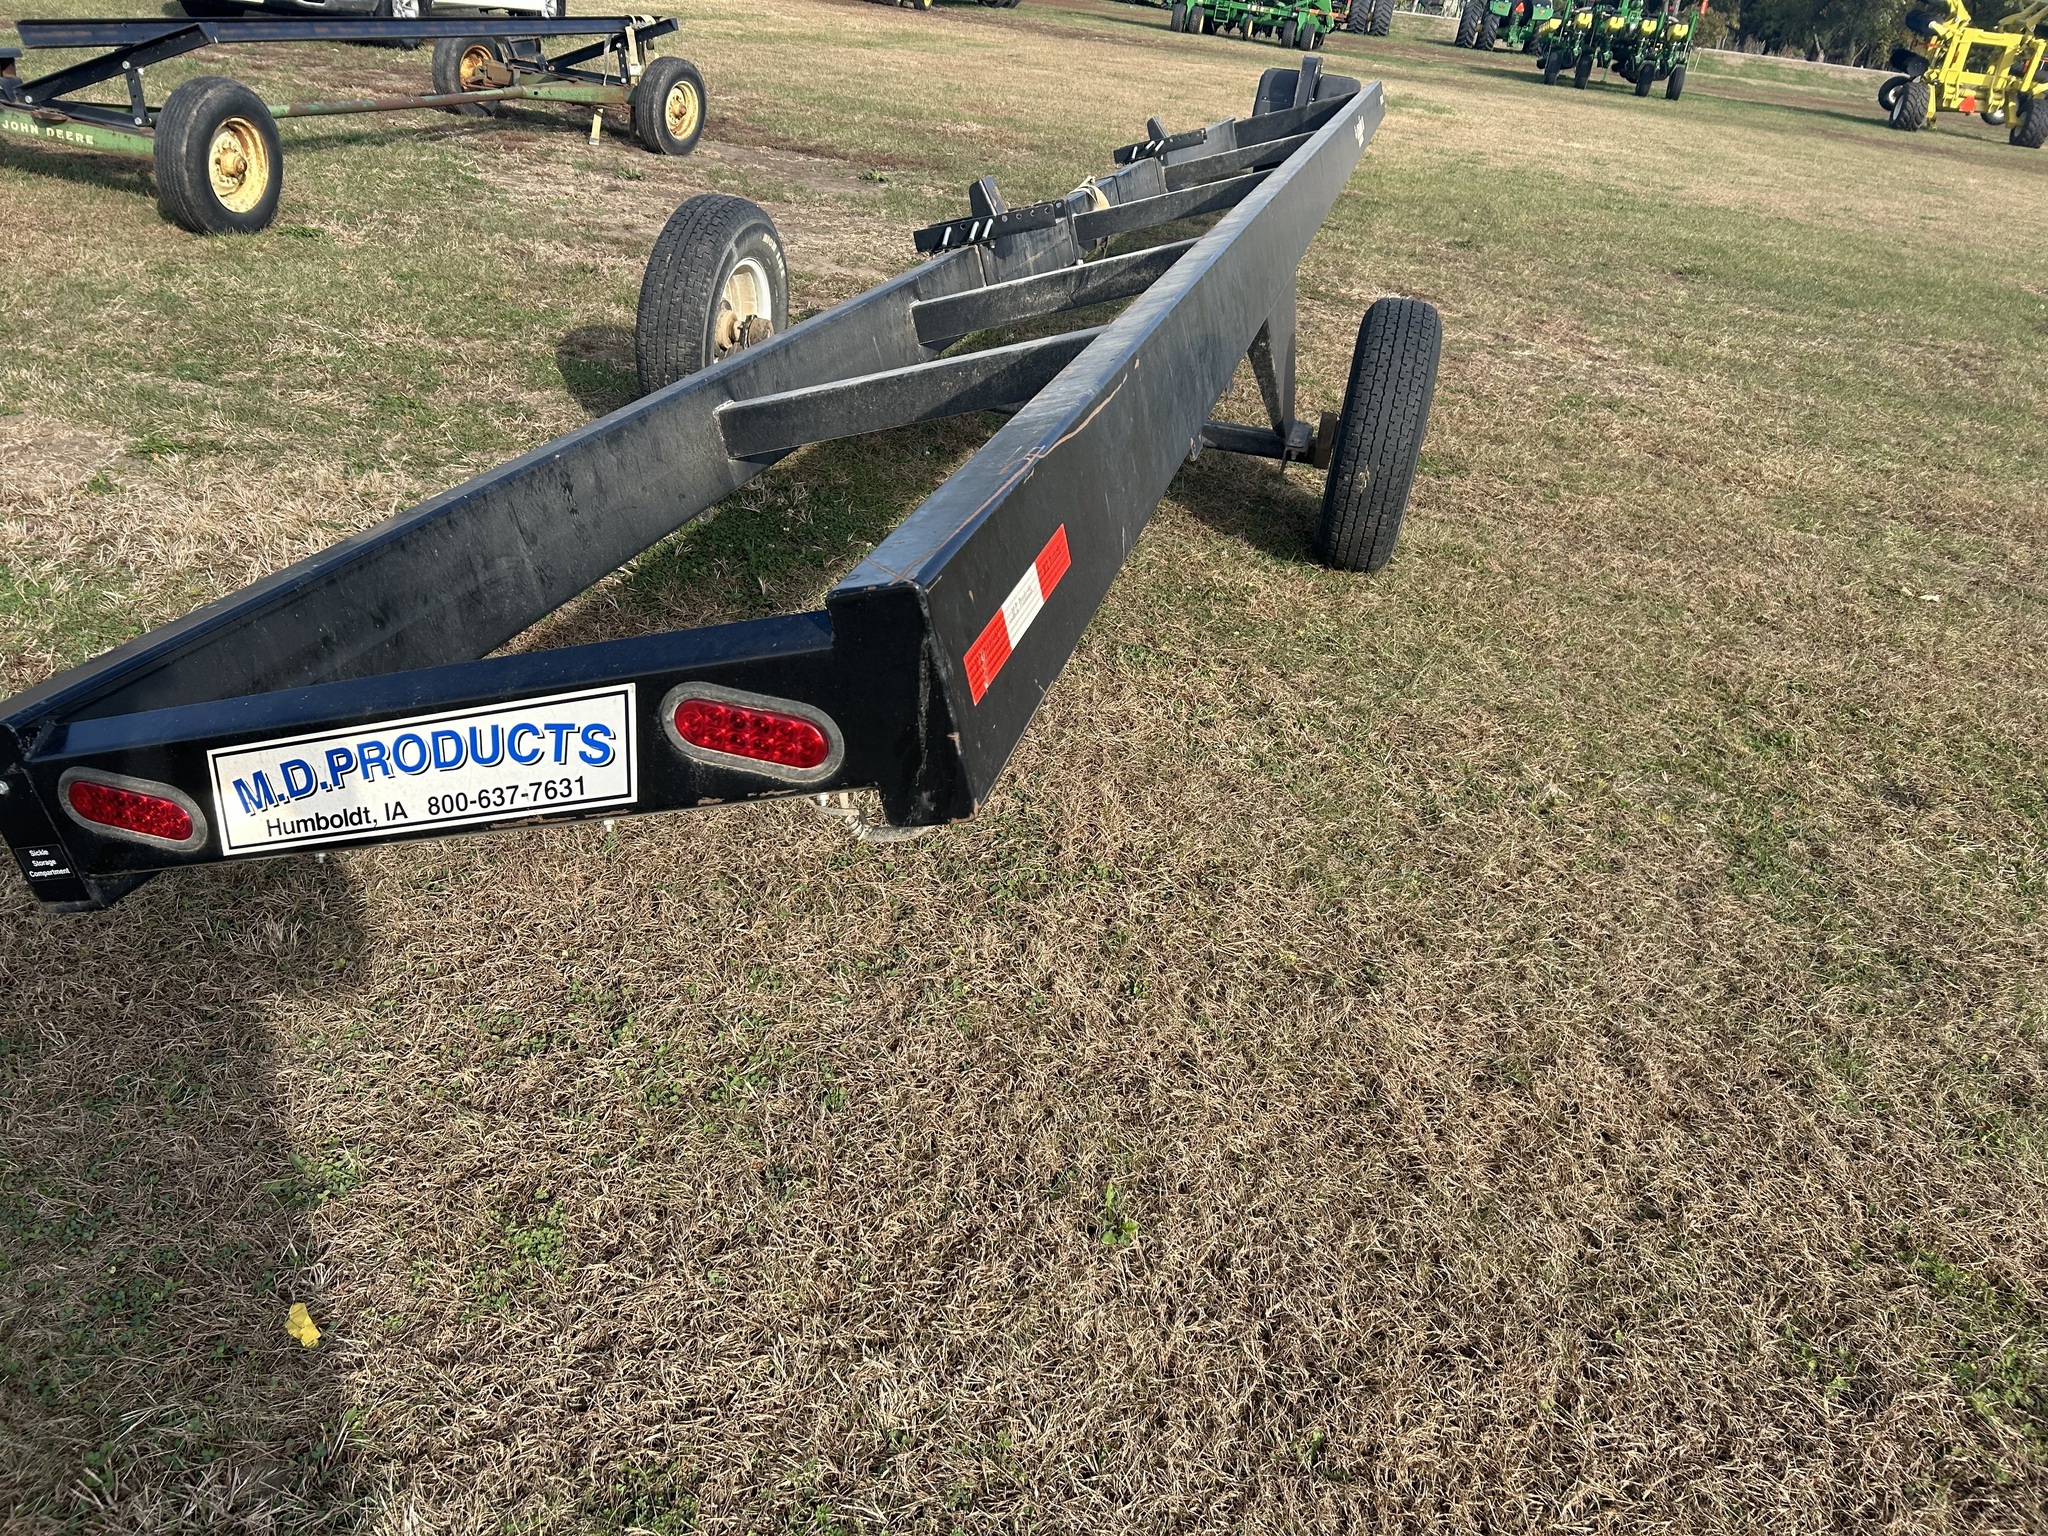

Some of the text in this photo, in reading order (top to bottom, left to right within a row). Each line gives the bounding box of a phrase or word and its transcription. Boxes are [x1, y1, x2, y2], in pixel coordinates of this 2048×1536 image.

[2, 120, 94, 145] JOHN DEERE
[232, 722, 615, 815] M.D.PRODUCTS
[266, 776, 586, 837] Humboldt, IA 800-637-7631
[29, 849, 49, 857] Sickle
[32, 859, 57, 867] Storage
[29, 868, 71, 877] Compartment
